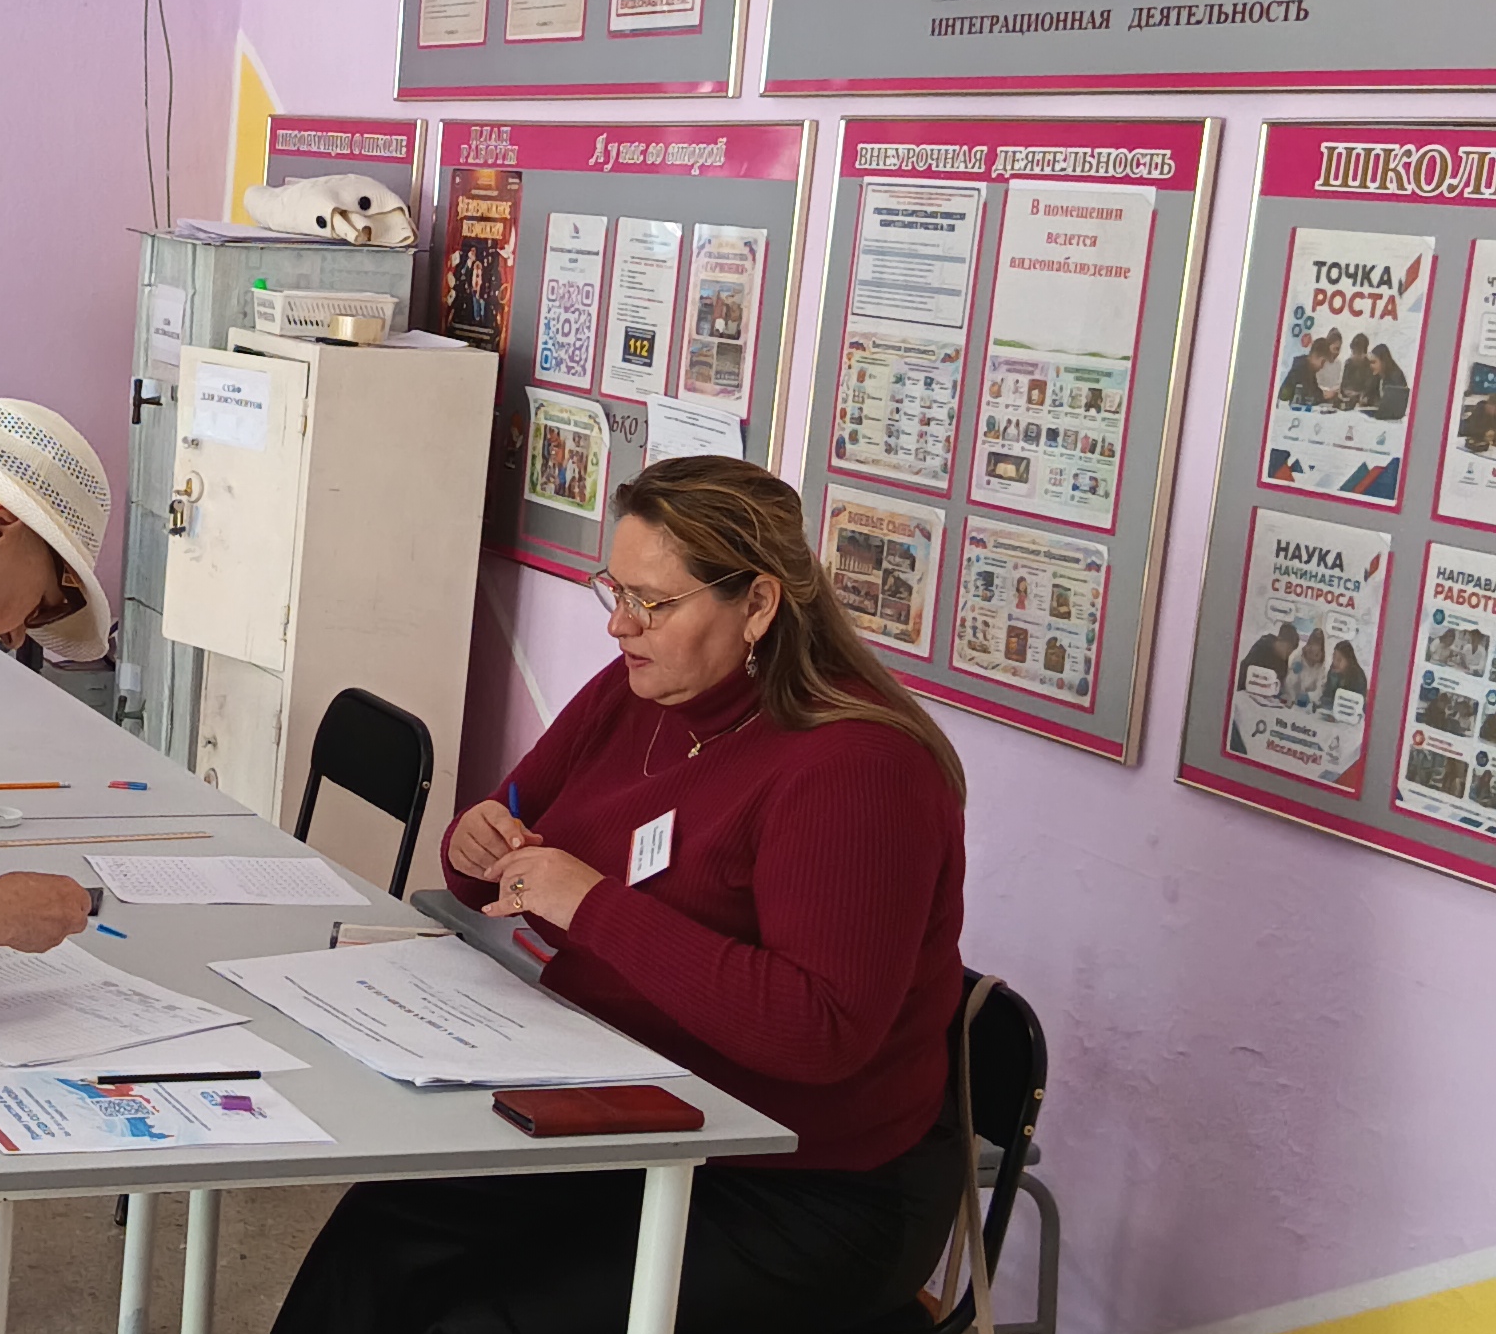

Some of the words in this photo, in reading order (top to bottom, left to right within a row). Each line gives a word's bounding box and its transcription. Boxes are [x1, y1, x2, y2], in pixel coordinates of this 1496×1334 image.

[929, 9, 1111, 38] ИНТЕГРАЦИОННАЯ
[1128, 0, 1310, 32] ДЕЯТЕЛЬНОСТЬ
[276, 129, 351, 155] ИНФОРМАЦИЯ
[362, 133, 408, 157] ШКОЛЕ
[470, 126, 512, 146] ПЛАН
[459, 144, 519, 165] РАБОТЫ
[857, 144, 986, 171] ВНЕУРОЧНАЯ
[993, 147, 1175, 178] ДЕЯТЕЛЬНОСТЬ
[1315, 142, 1496, 197] ШКОЛ
[1029, 198, 1041, 216] В
[1312, 260, 1394, 290] ТОЧКА
[1311, 287, 1399, 321] РОСТА
[629, 338, 650, 357] 112
[1275, 539, 1345, 573] НАУКА
[1272, 562, 1361, 593] НАЧИНАЕТСЯ
[1271, 580, 1280, 593] С
[1284, 581, 1356, 610] ВОПРОСА
